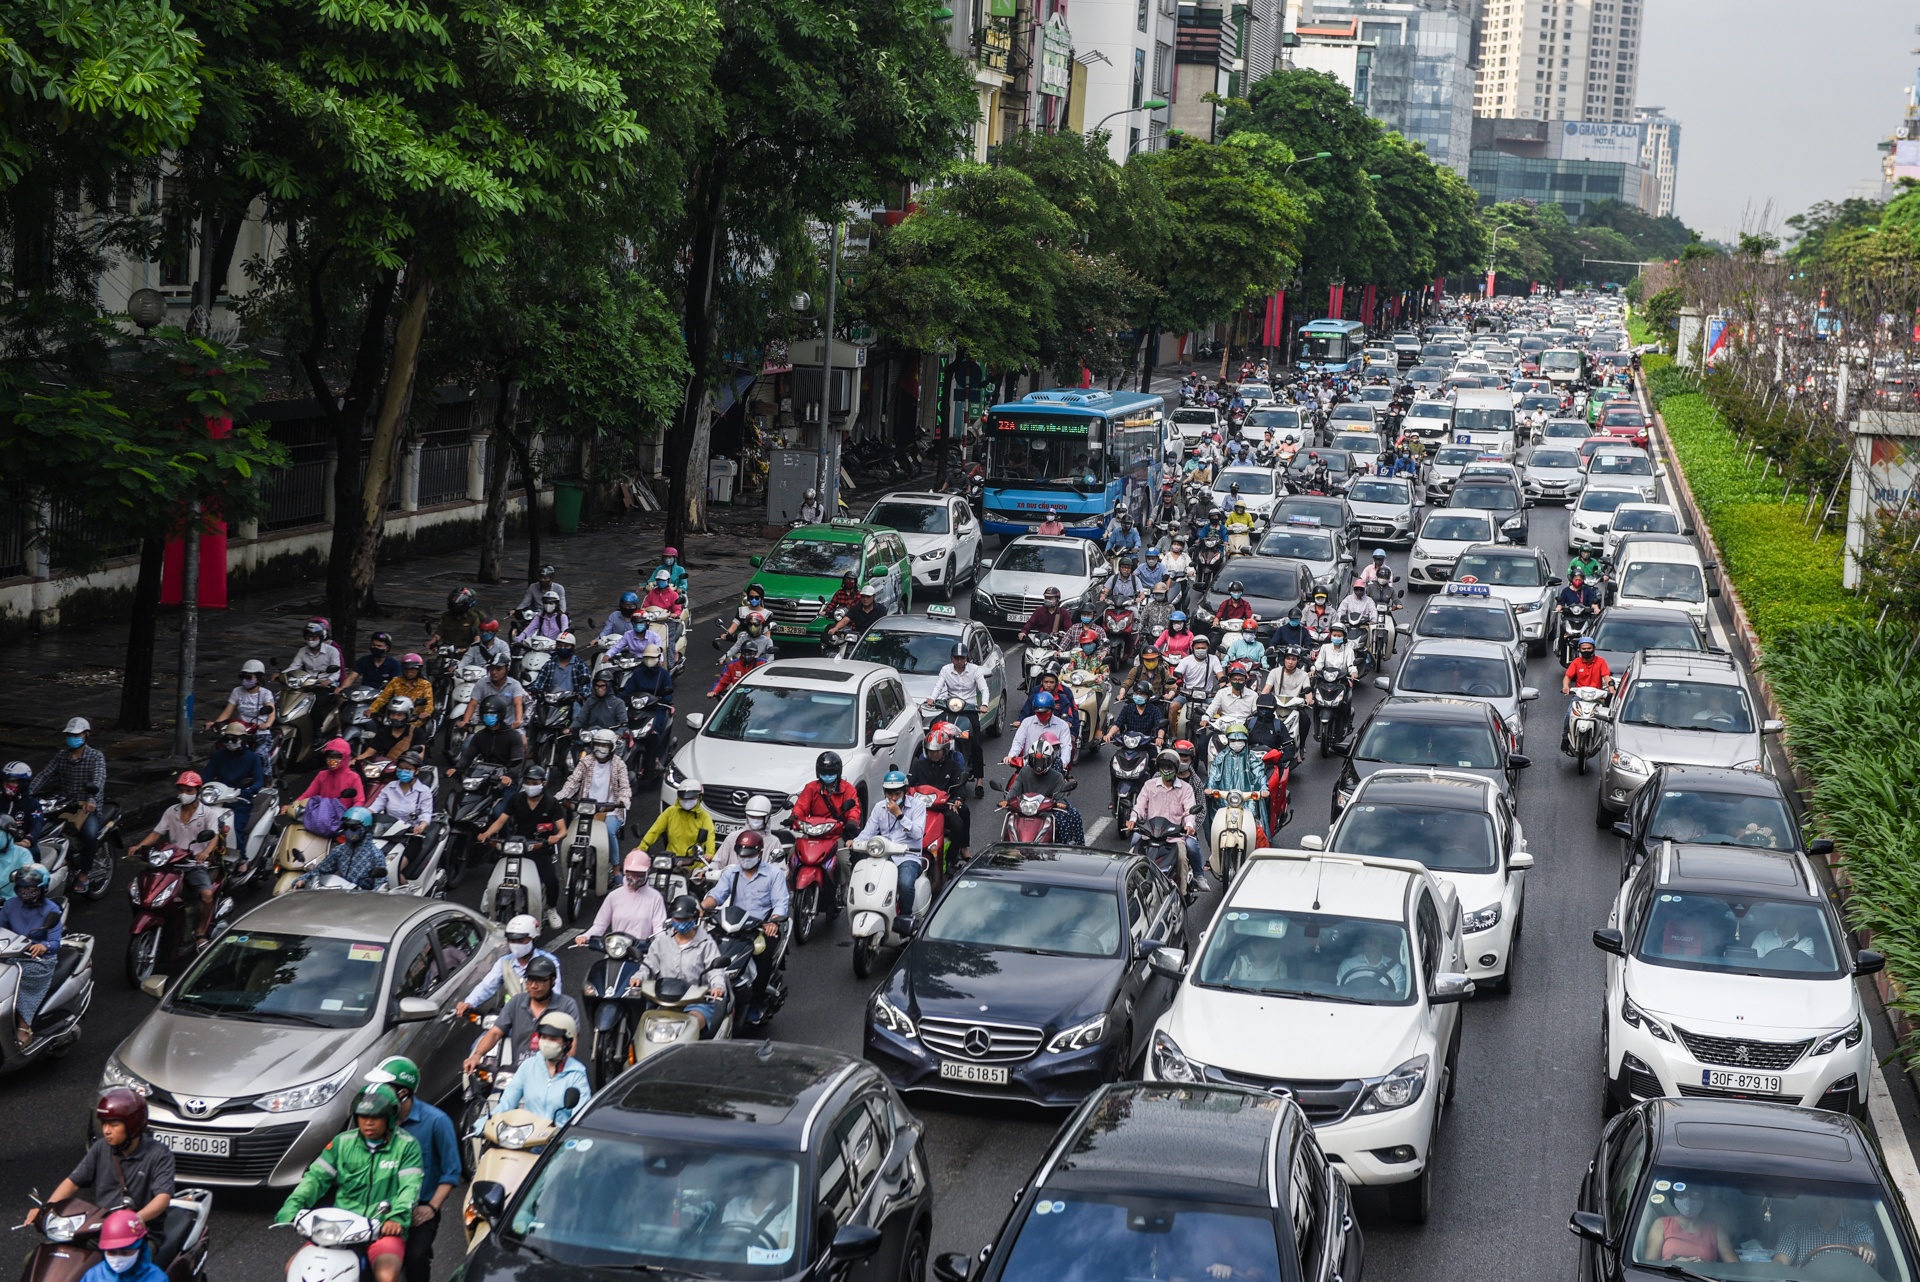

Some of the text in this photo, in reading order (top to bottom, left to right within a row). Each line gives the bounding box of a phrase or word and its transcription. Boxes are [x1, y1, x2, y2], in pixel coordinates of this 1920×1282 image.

[1579, 124, 1637, 138] GRAND PLAZA
[998, 420, 1016, 430] 22A
[832, 518, 851, 526] TAXI
[930, 604, 953, 614] TAXI
[399, 1071, 417, 1084] Grab
[943, 1063, 1005, 1082] 30E-618.51
[1711, 1072, 1778, 1090] 30F-879.19
